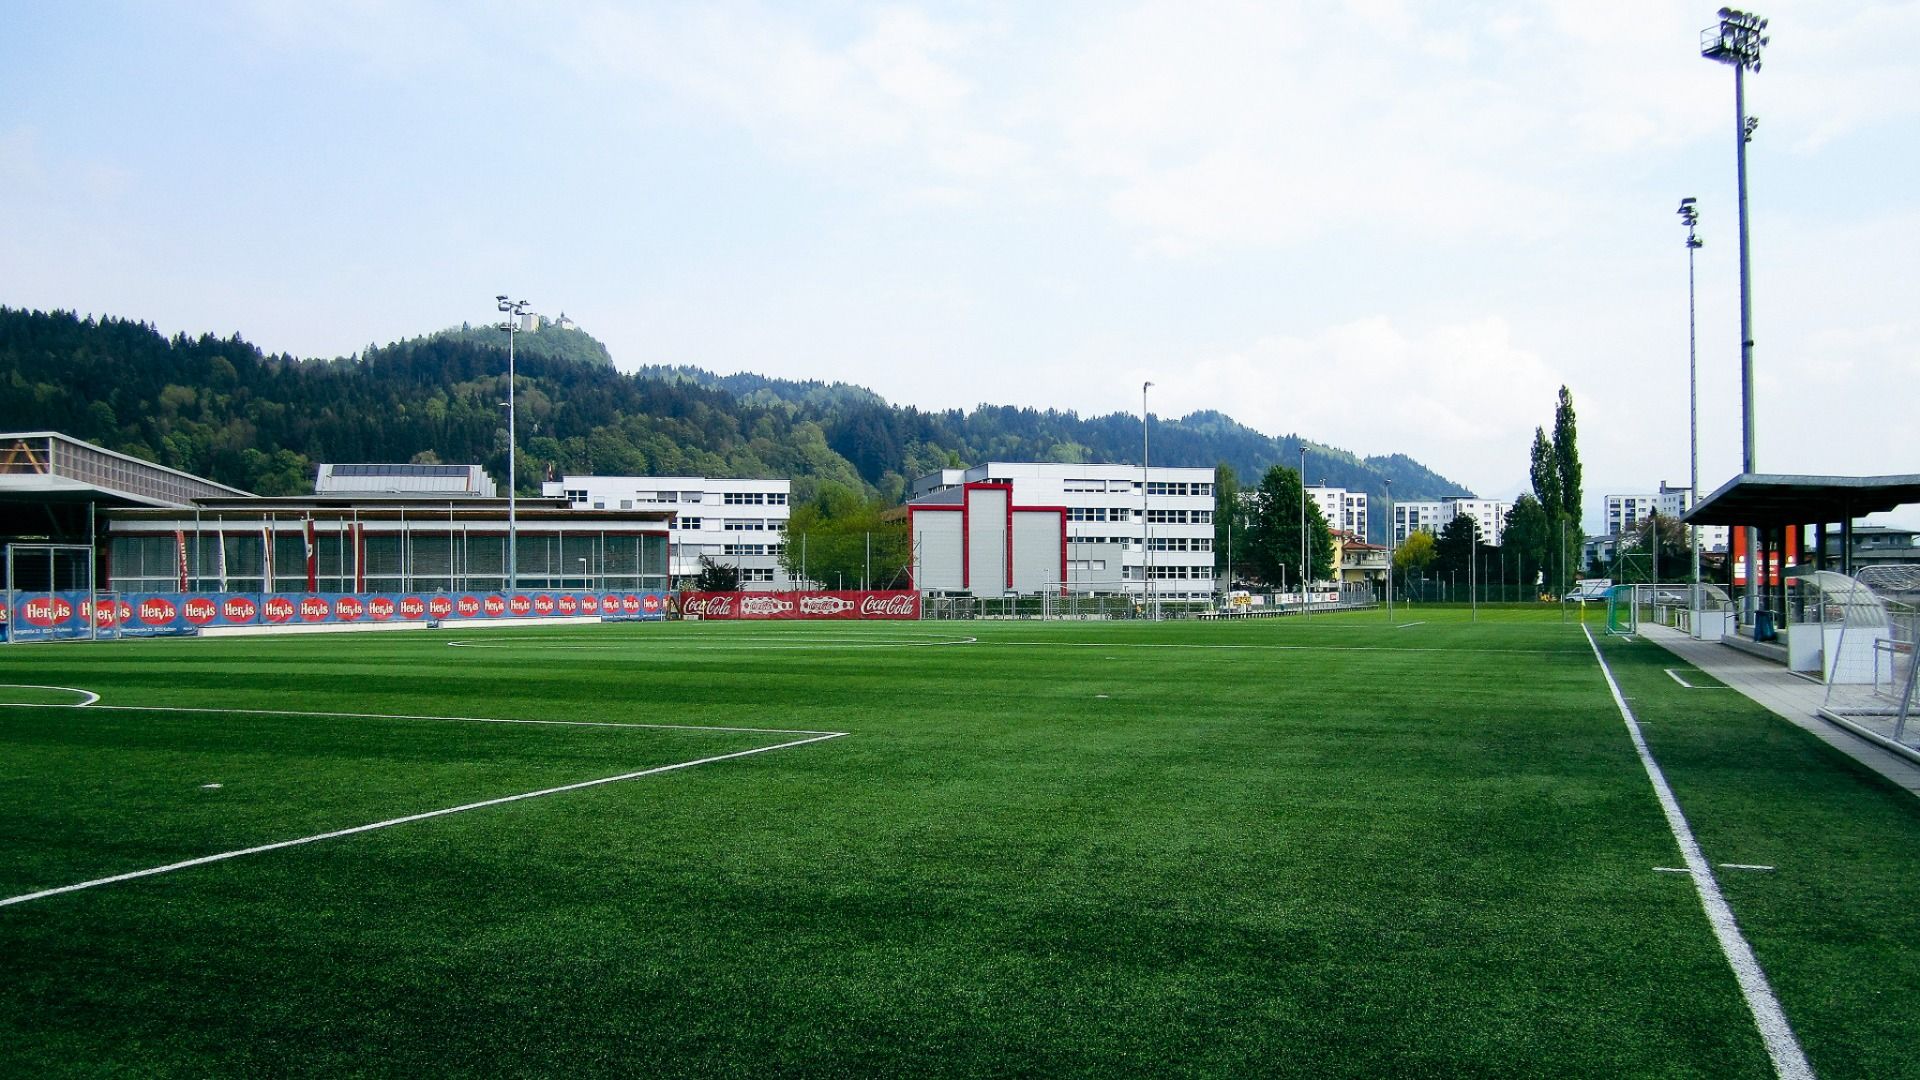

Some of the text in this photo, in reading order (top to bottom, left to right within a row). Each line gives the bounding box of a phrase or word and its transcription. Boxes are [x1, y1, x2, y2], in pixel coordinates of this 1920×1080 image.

[27, 604, 70, 619] Hervis
[185, 603, 216, 619] Hervis
[225, 603, 255, 618] Hervis
[265, 603, 293, 617] Hervis
[300, 603, 328, 617] Hervis
[336, 602, 362, 616] Hervis
[369, 602, 394, 615] Hervis
[400, 602, 424, 614] Hervis
[429, 602, 451, 614] Hervis
[458, 601, 479, 613] Hervis
[861, 594, 917, 615] Coca-Cola
[141, 604, 175, 620] Hervis
